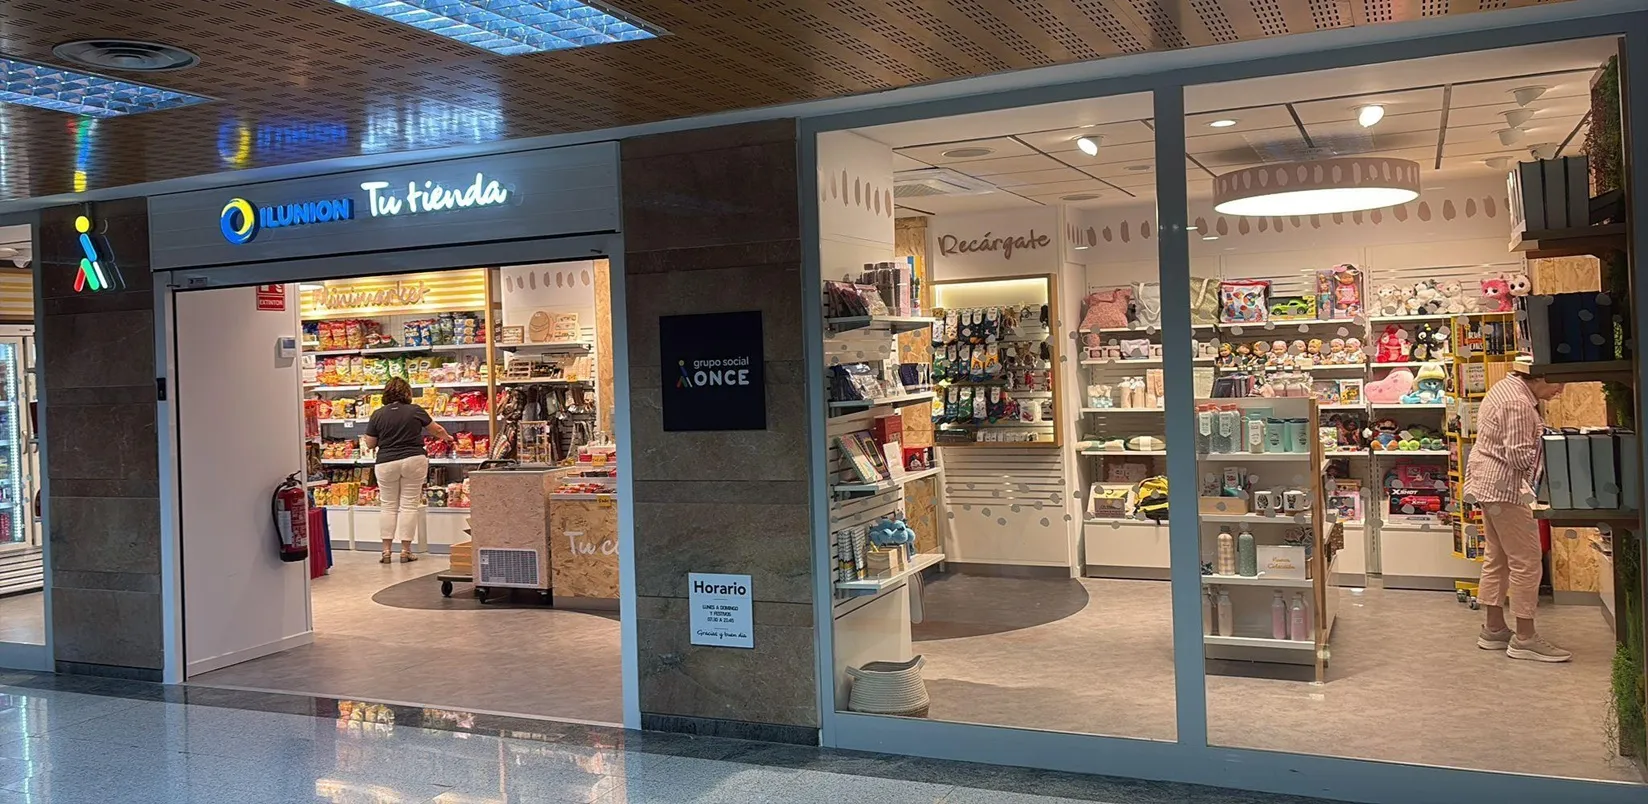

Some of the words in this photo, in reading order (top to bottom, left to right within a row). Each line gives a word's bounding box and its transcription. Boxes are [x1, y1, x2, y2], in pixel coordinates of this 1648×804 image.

[360, 181, 402, 217] Tu
[405, 172, 508, 214] tienda
[260, 199, 354, 229] ILUNION
[938, 229, 1051, 260] Recárgate
[312, 280, 430, 311] Minimarket
[693, 360, 722, 370] grupo
[722, 356, 749, 366] social
[694, 370, 750, 386] ONCE
[563, 531, 596, 556] Tu
[694, 580, 746, 595] Horario
